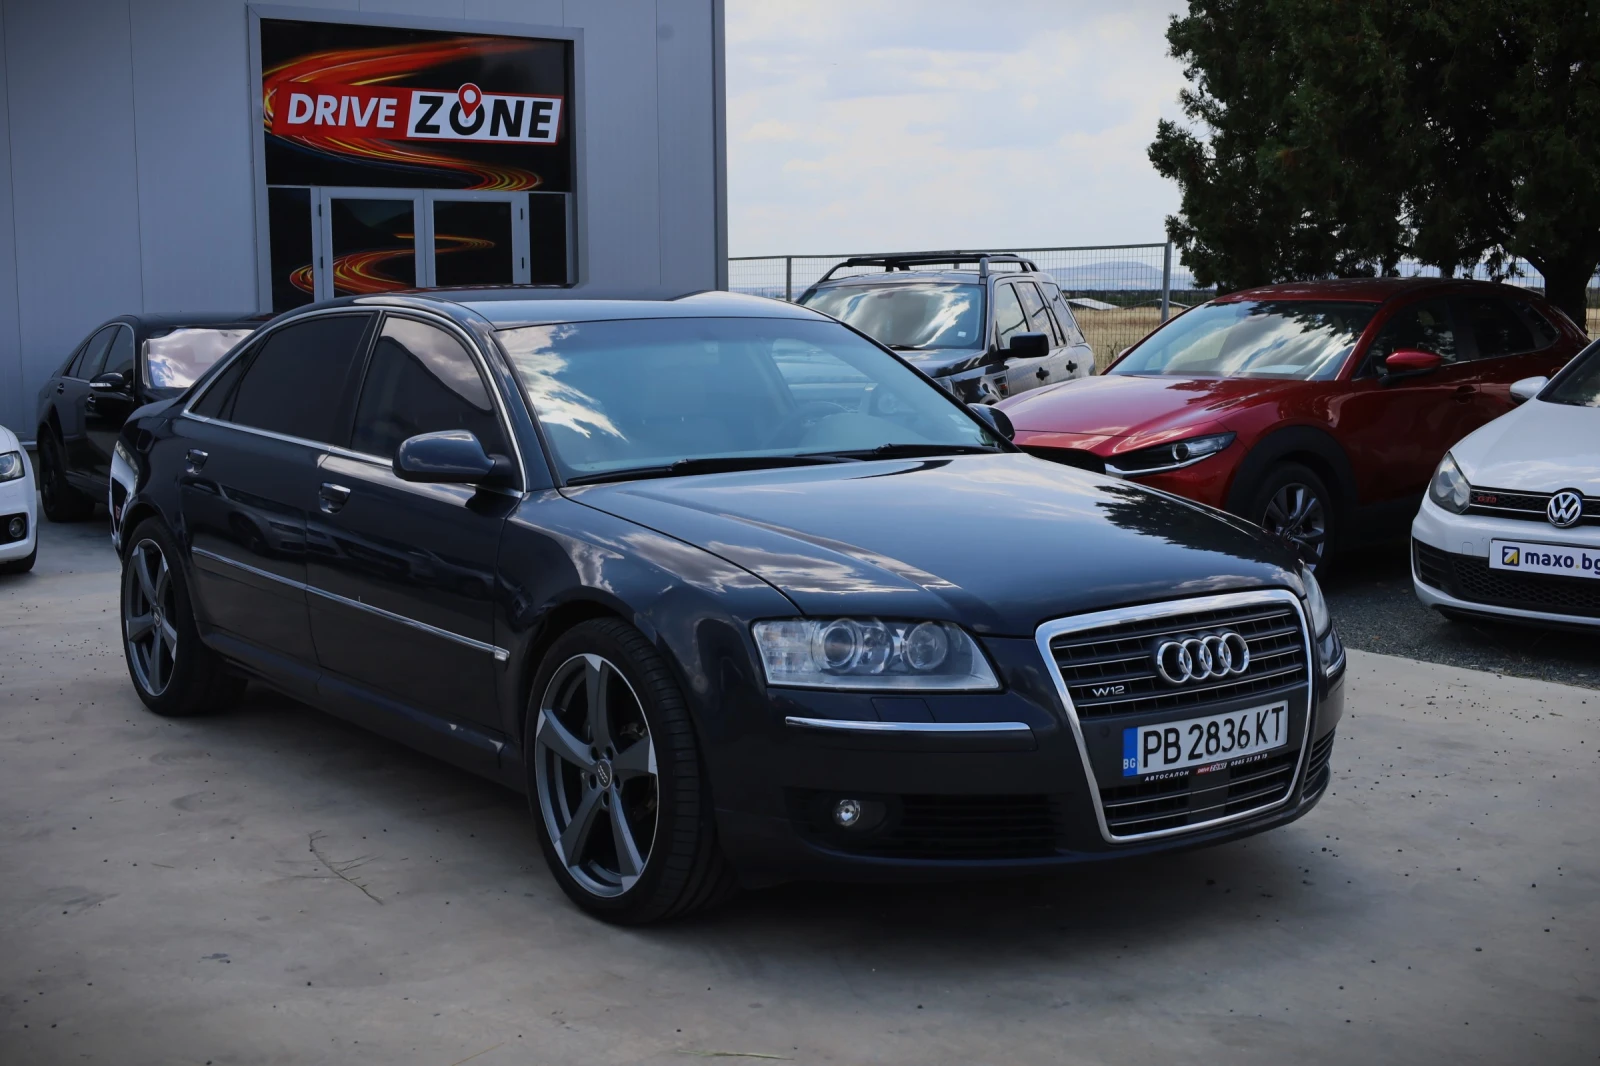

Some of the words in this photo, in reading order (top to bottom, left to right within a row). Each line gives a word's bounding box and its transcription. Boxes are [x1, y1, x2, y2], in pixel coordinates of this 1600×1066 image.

[287, 92, 398, 128] DRIVE
[414, 95, 554, 139] ZONE
[1524, 552, 1600, 576] maxo.bg
[1092, 685, 1125, 697] W12
[1143, 727, 1181, 768] PB
[1187, 714, 1251, 761] 2836
[1255, 705, 1285, 746] KT
[1123, 758, 1136, 770] BG
